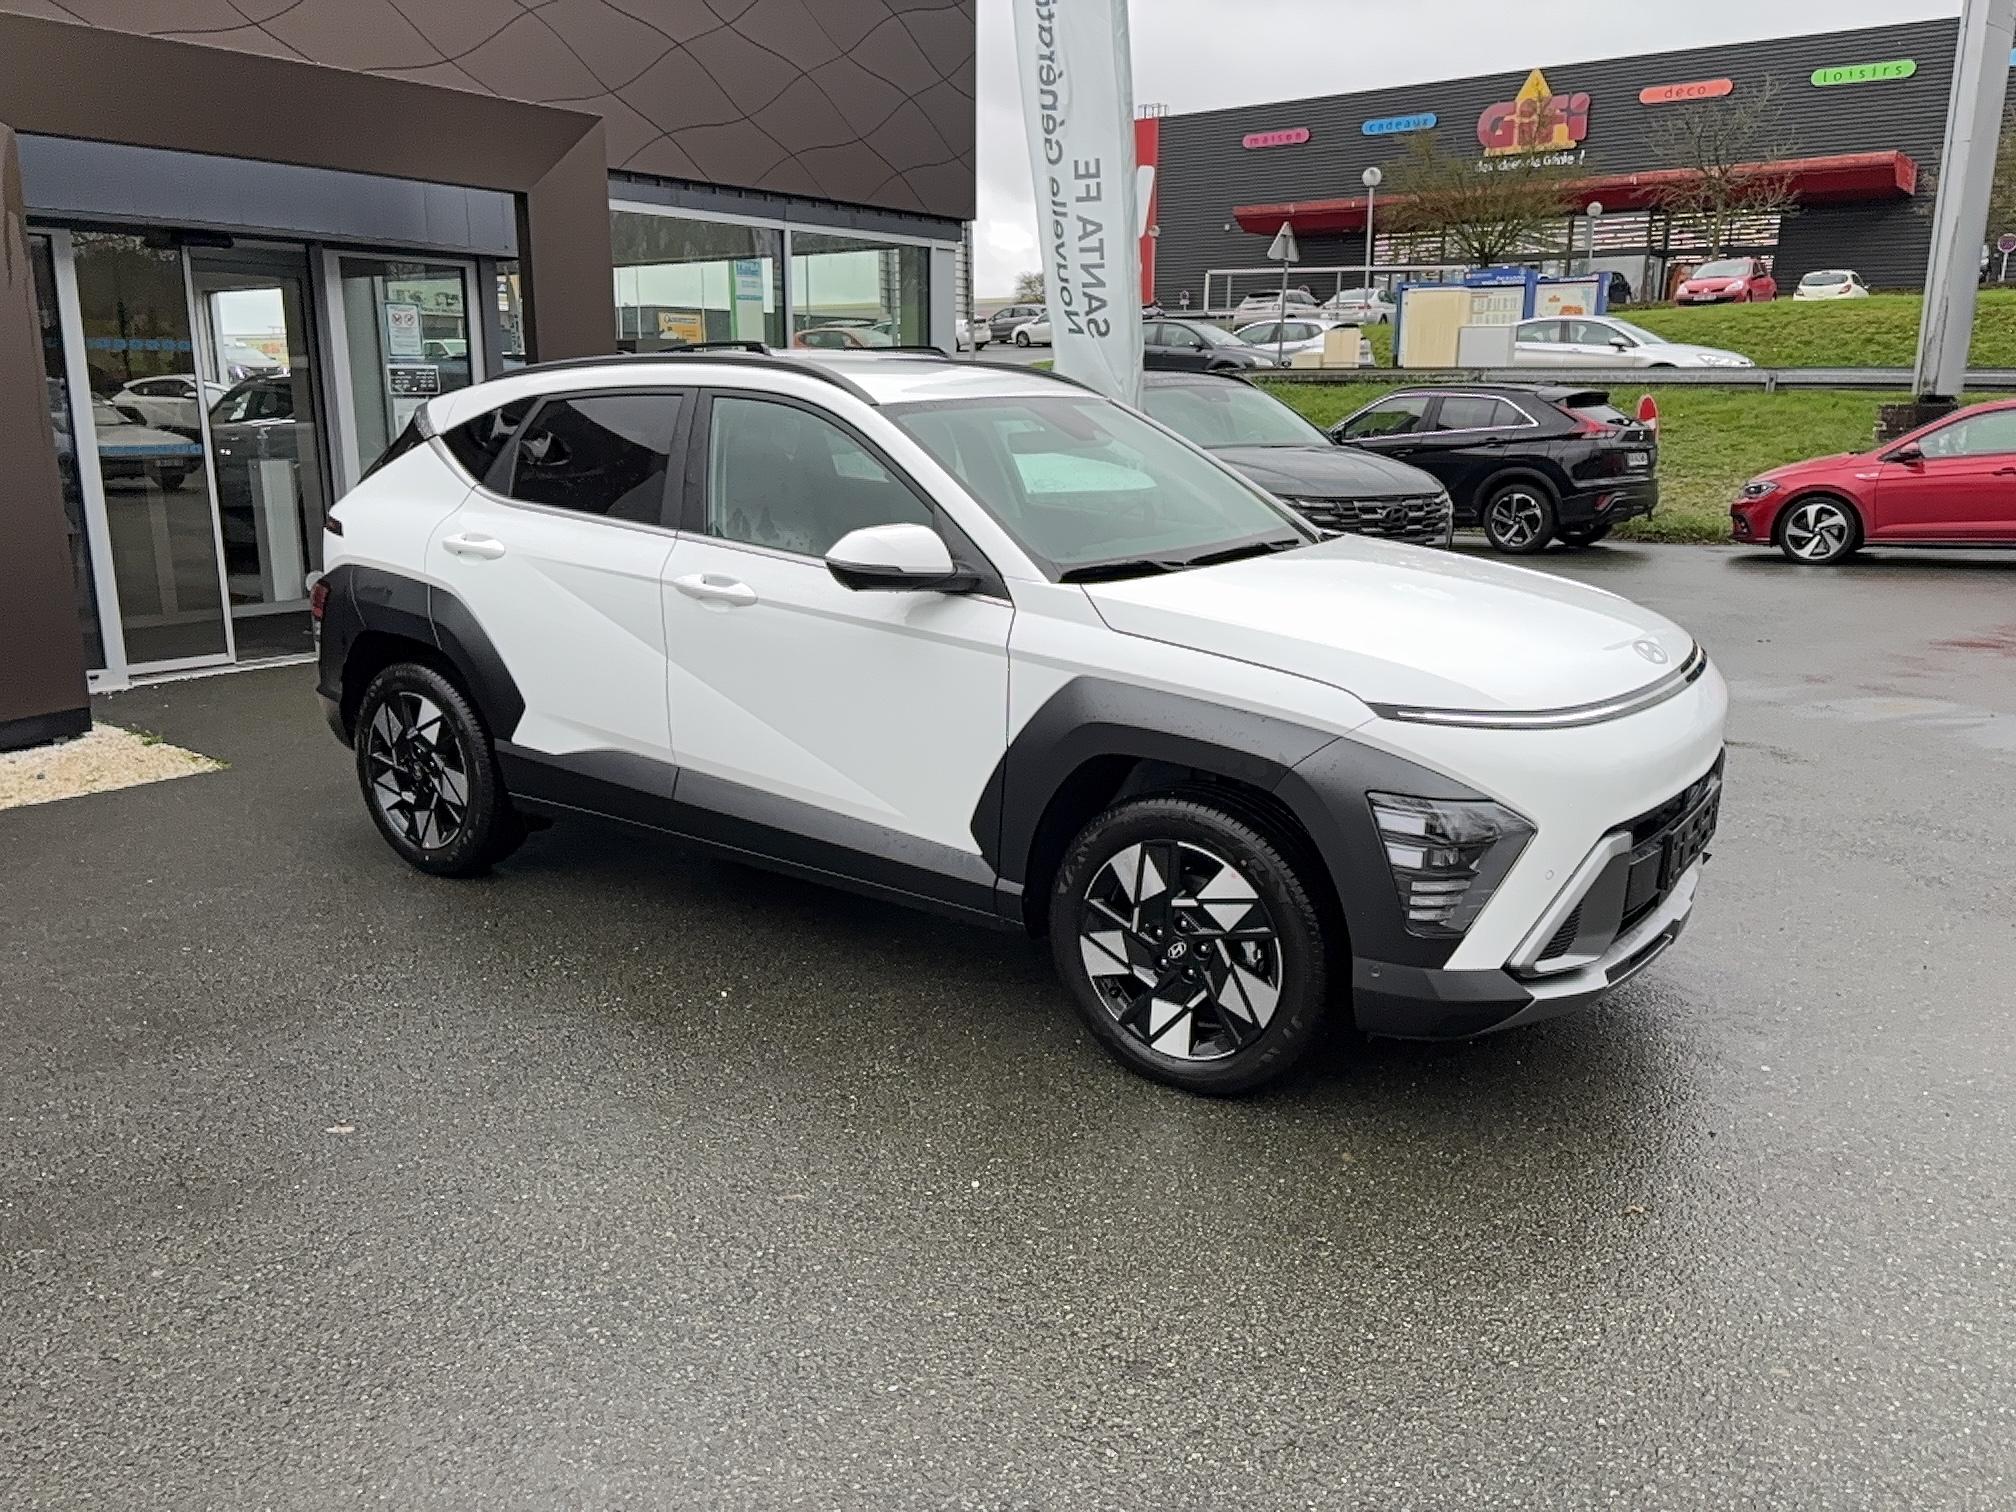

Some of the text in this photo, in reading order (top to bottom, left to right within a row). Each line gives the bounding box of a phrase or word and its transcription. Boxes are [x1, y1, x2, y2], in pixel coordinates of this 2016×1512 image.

[1823, 65, 1903, 83] loisirs
[1369, 117, 1429, 133] cadeaux
[1249, 131, 1302, 146] maison
